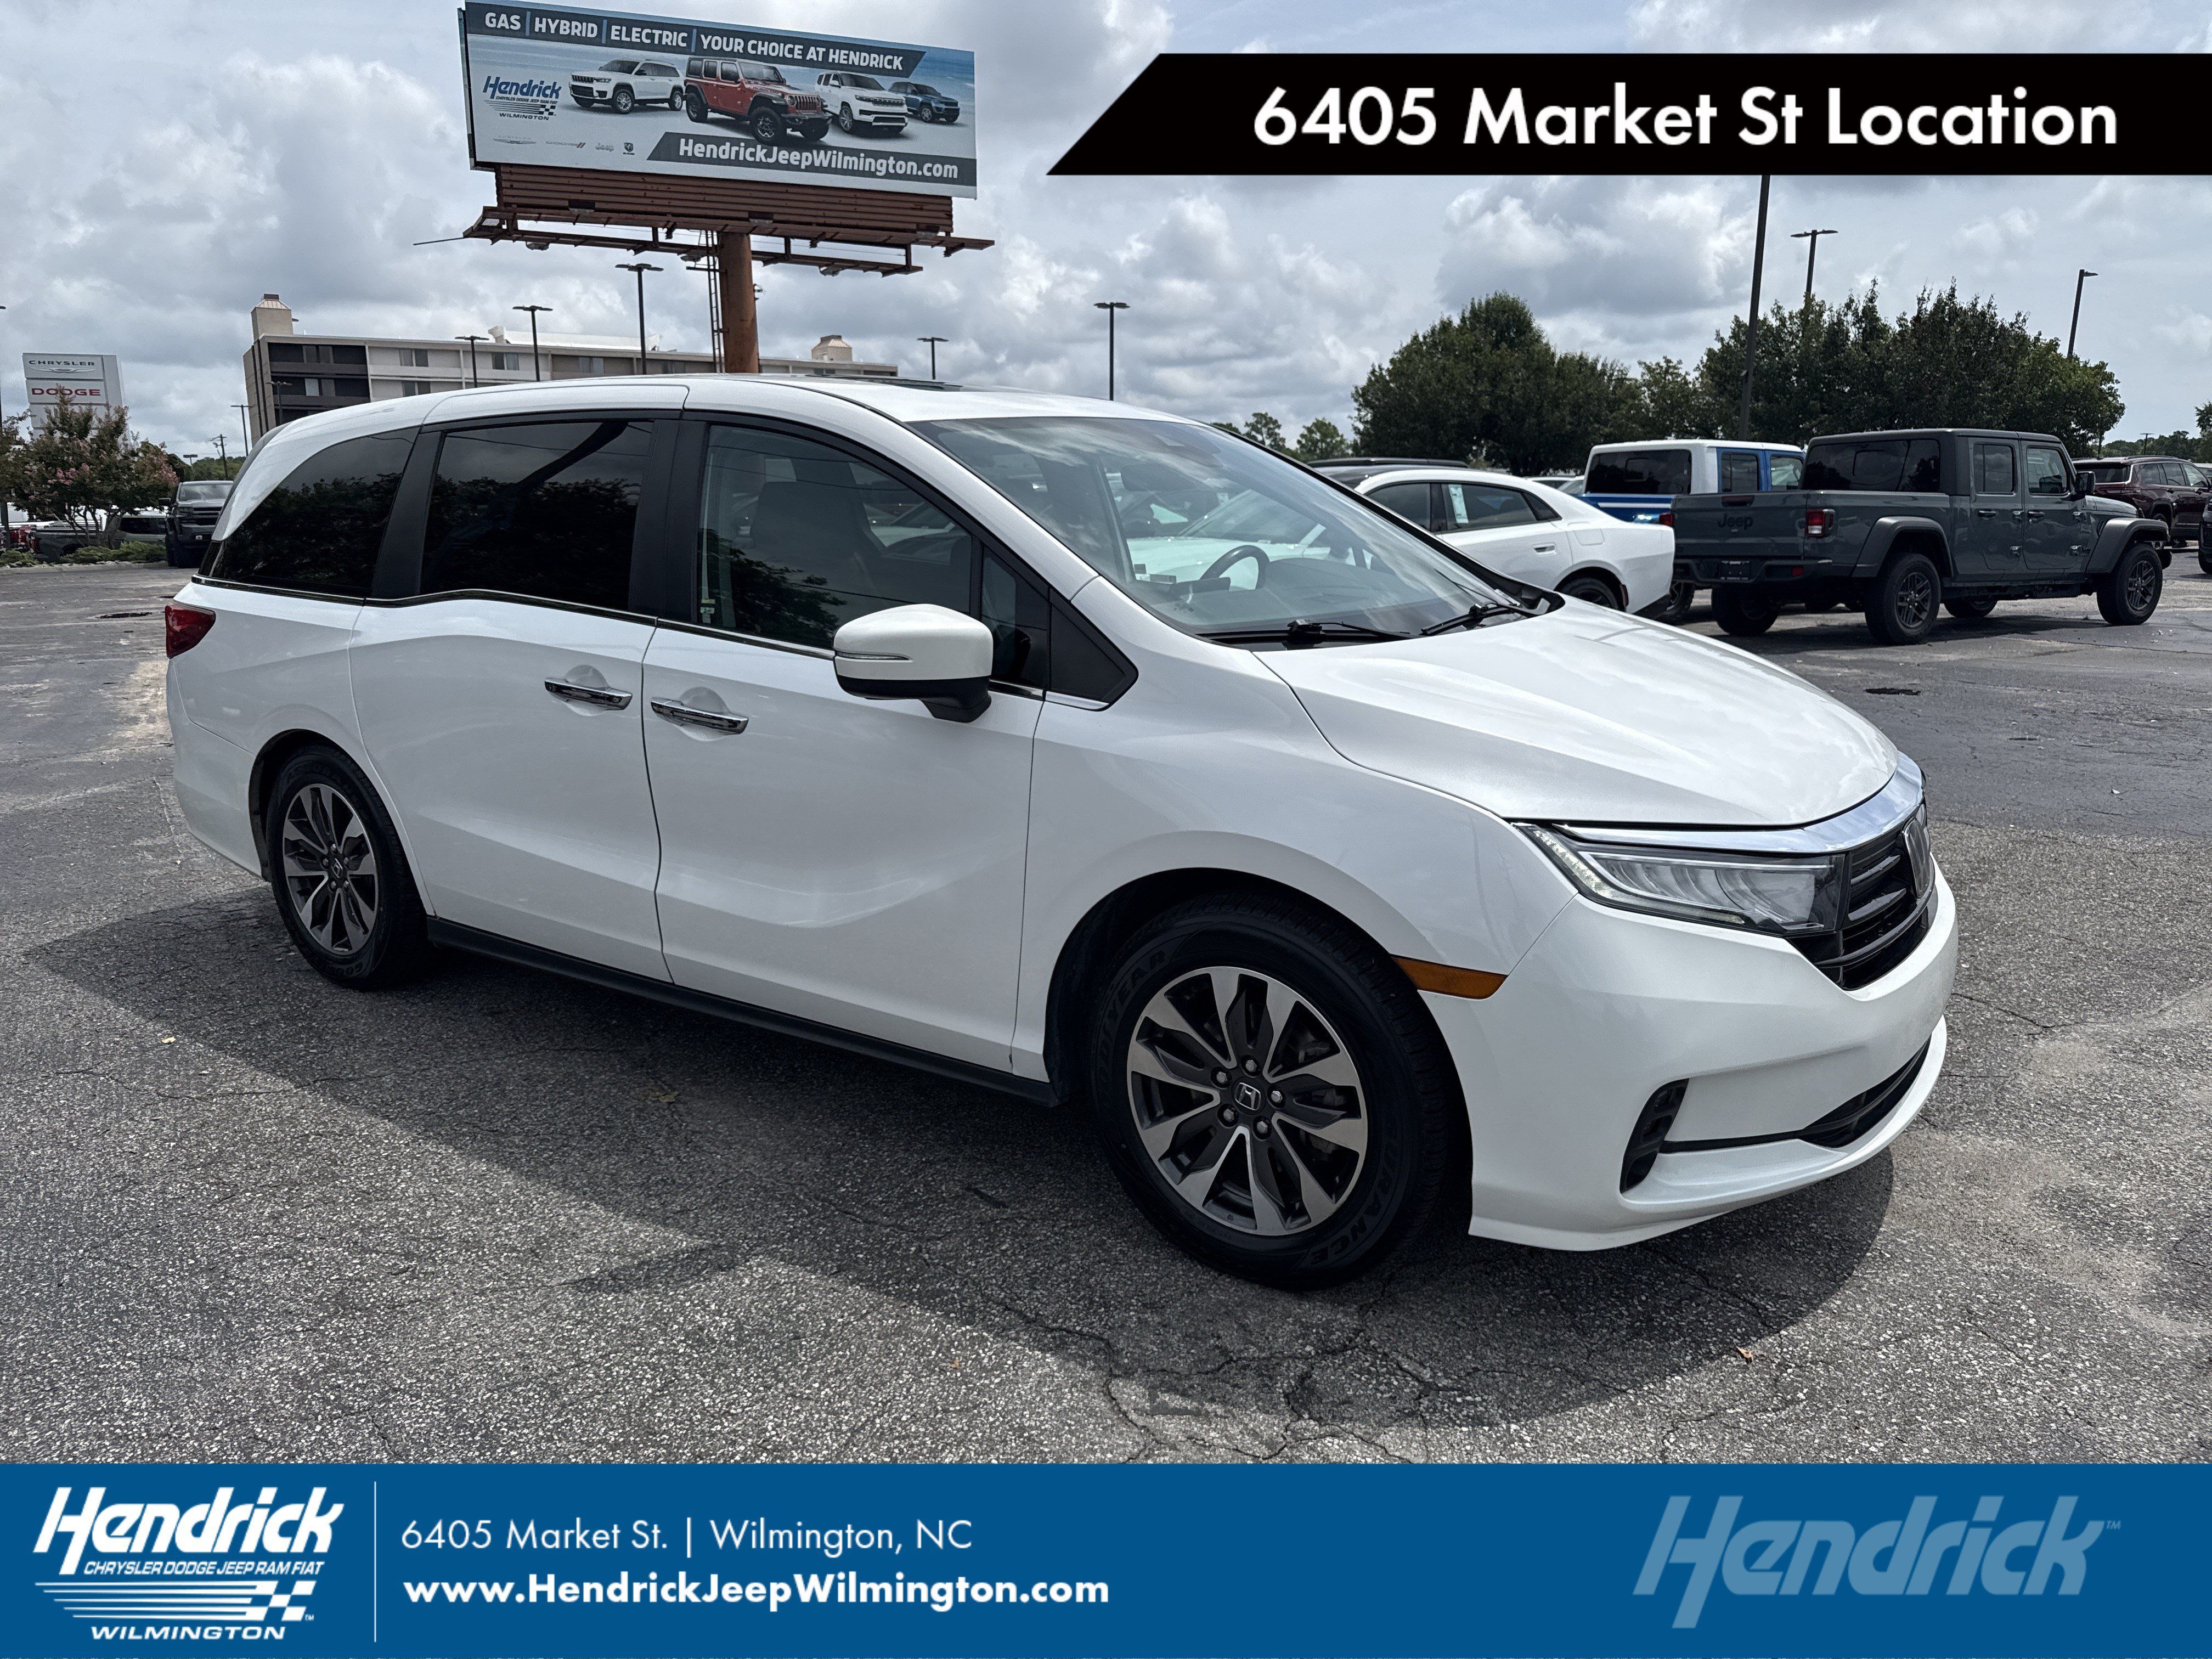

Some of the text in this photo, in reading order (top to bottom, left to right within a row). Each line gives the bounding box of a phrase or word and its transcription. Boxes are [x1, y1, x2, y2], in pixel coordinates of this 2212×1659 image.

[485, 12, 904, 70] GAS HYBRID ELECTRIC YOUR CHOICE AT HENDRICK
[483, 76, 562, 99] Hendrick
[679, 138, 958, 179] HendrickJeepWilmington.com
[1718, 514, 1753, 530] Jeep
